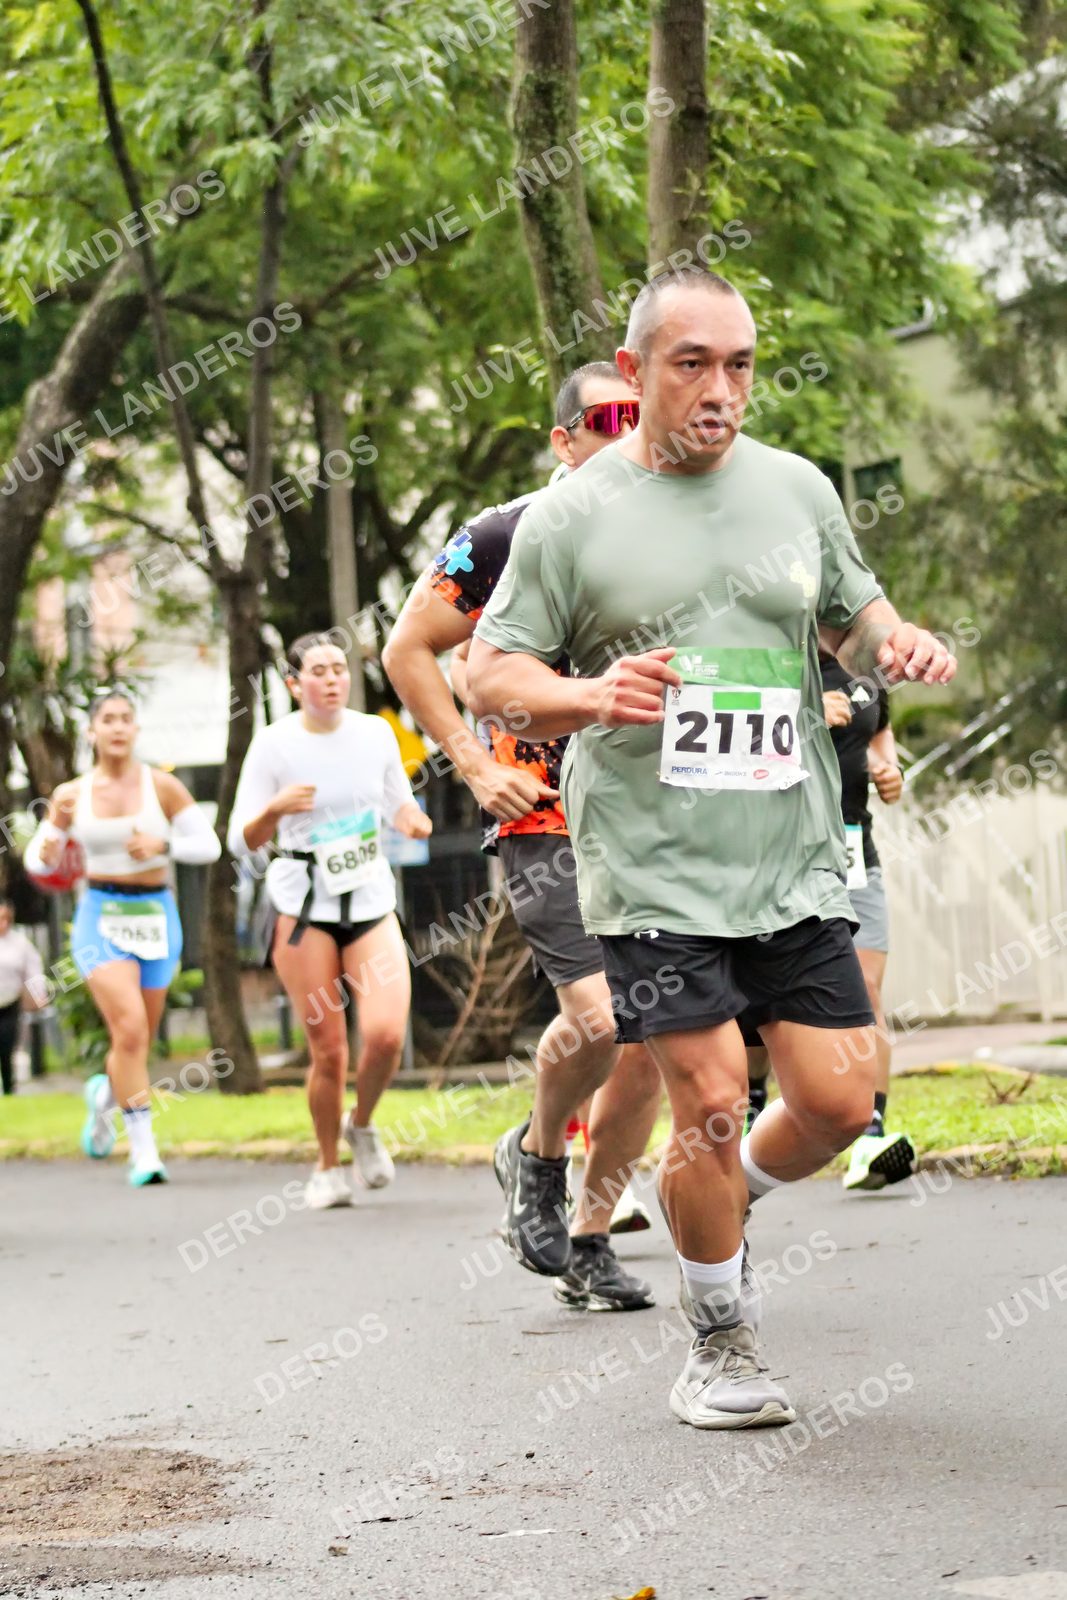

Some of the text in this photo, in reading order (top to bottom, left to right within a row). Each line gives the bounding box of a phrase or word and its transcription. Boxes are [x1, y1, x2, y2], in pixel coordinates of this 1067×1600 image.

[674, 710, 794, 756] 2110
[671, 766, 708, 776] PERDURA
[326, 841, 377, 874] 6809
